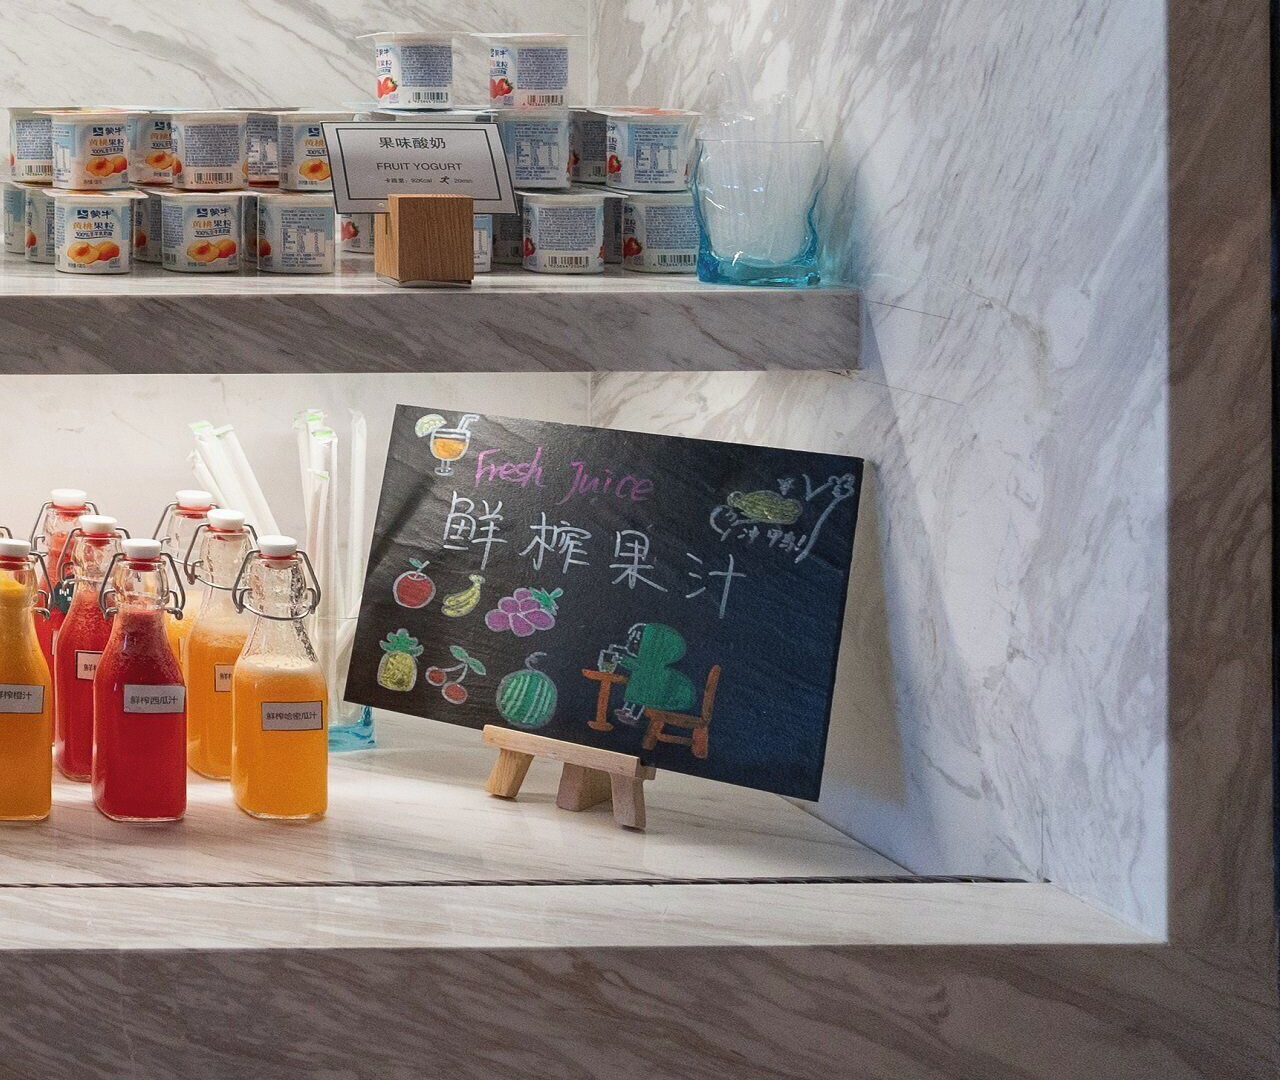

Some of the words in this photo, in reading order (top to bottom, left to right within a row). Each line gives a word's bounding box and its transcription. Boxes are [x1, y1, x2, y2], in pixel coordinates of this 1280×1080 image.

[379, 136, 446, 149] 果味酸奶
[376, 162, 410, 171] FRUIT
[413, 162, 462, 171] YOGURT
[474, 446, 546, 488] Fresh
[555, 461, 655, 505] Juice
[443, 491, 747, 619] 鲜榨果汁
[130, 695, 179, 705] 鲜榨西瓜汁
